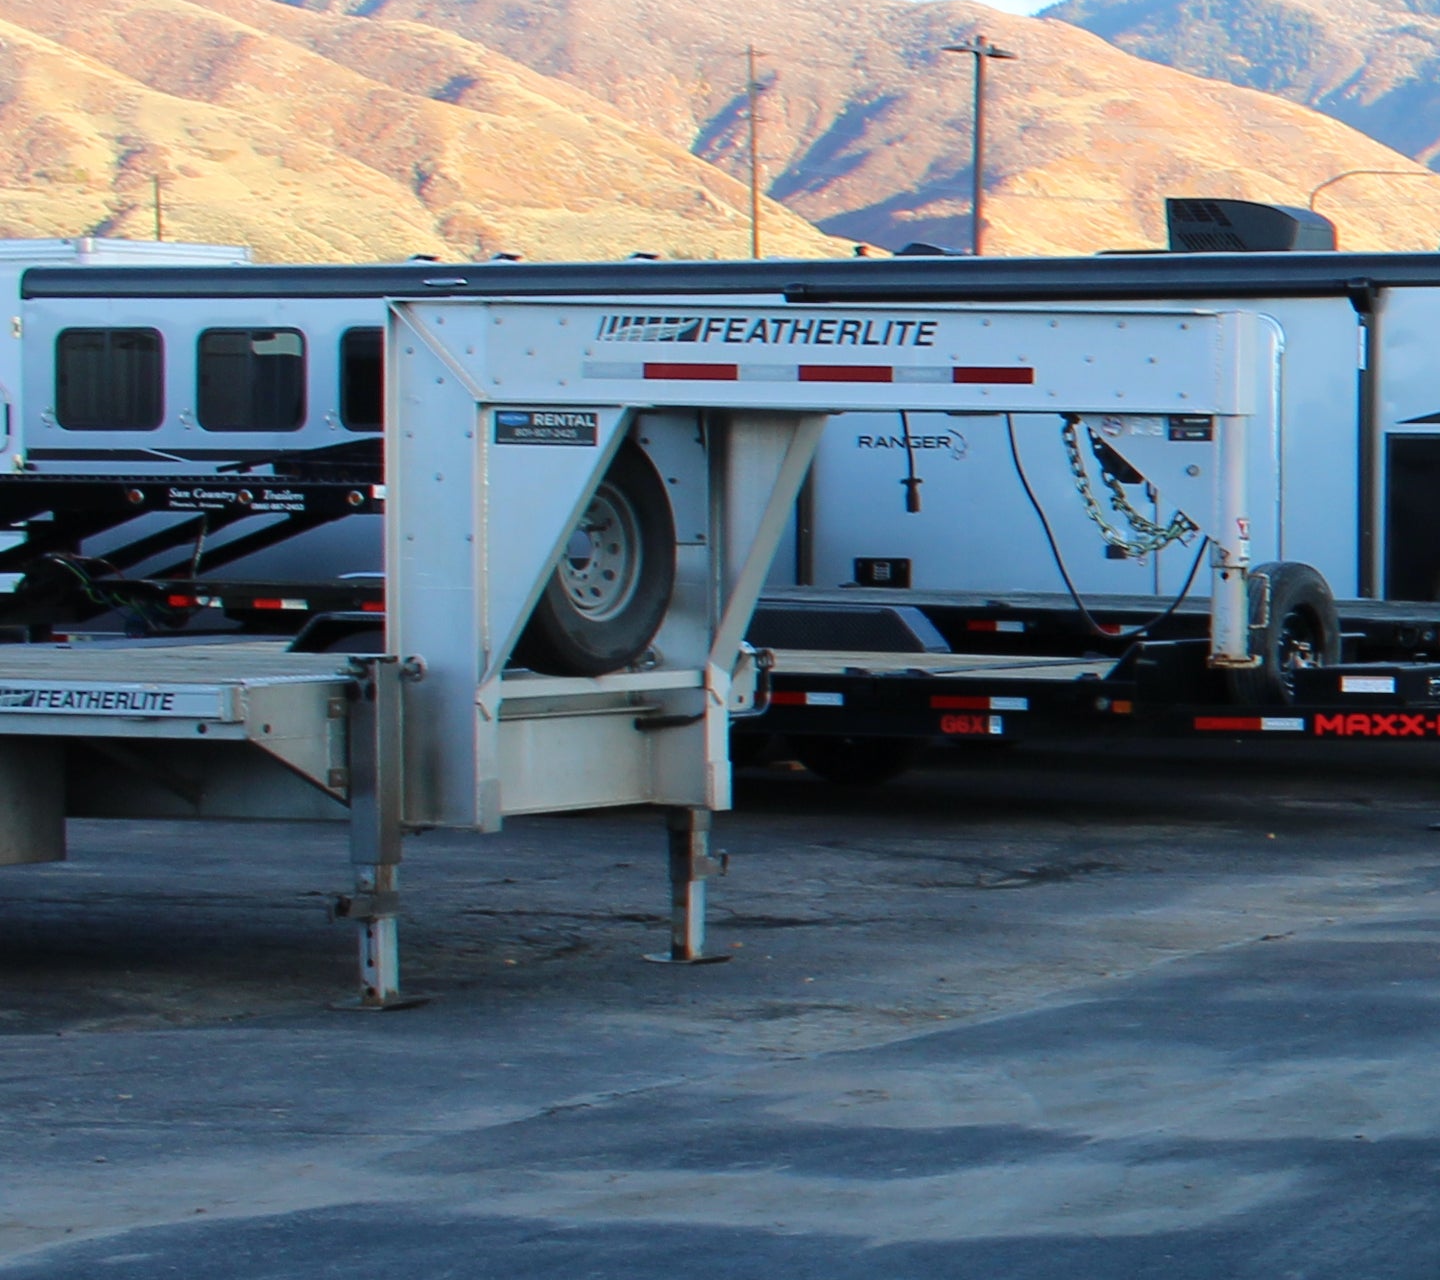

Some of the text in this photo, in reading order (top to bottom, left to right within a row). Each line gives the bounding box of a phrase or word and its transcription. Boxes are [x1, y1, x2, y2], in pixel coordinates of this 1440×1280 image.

[702, 316, 939, 347] FEATHERLITE
[533, 413, 596, 427] RENTAL
[858, 435, 952, 449] RANGER
[35, 689, 176, 711] FEATHERLITE
